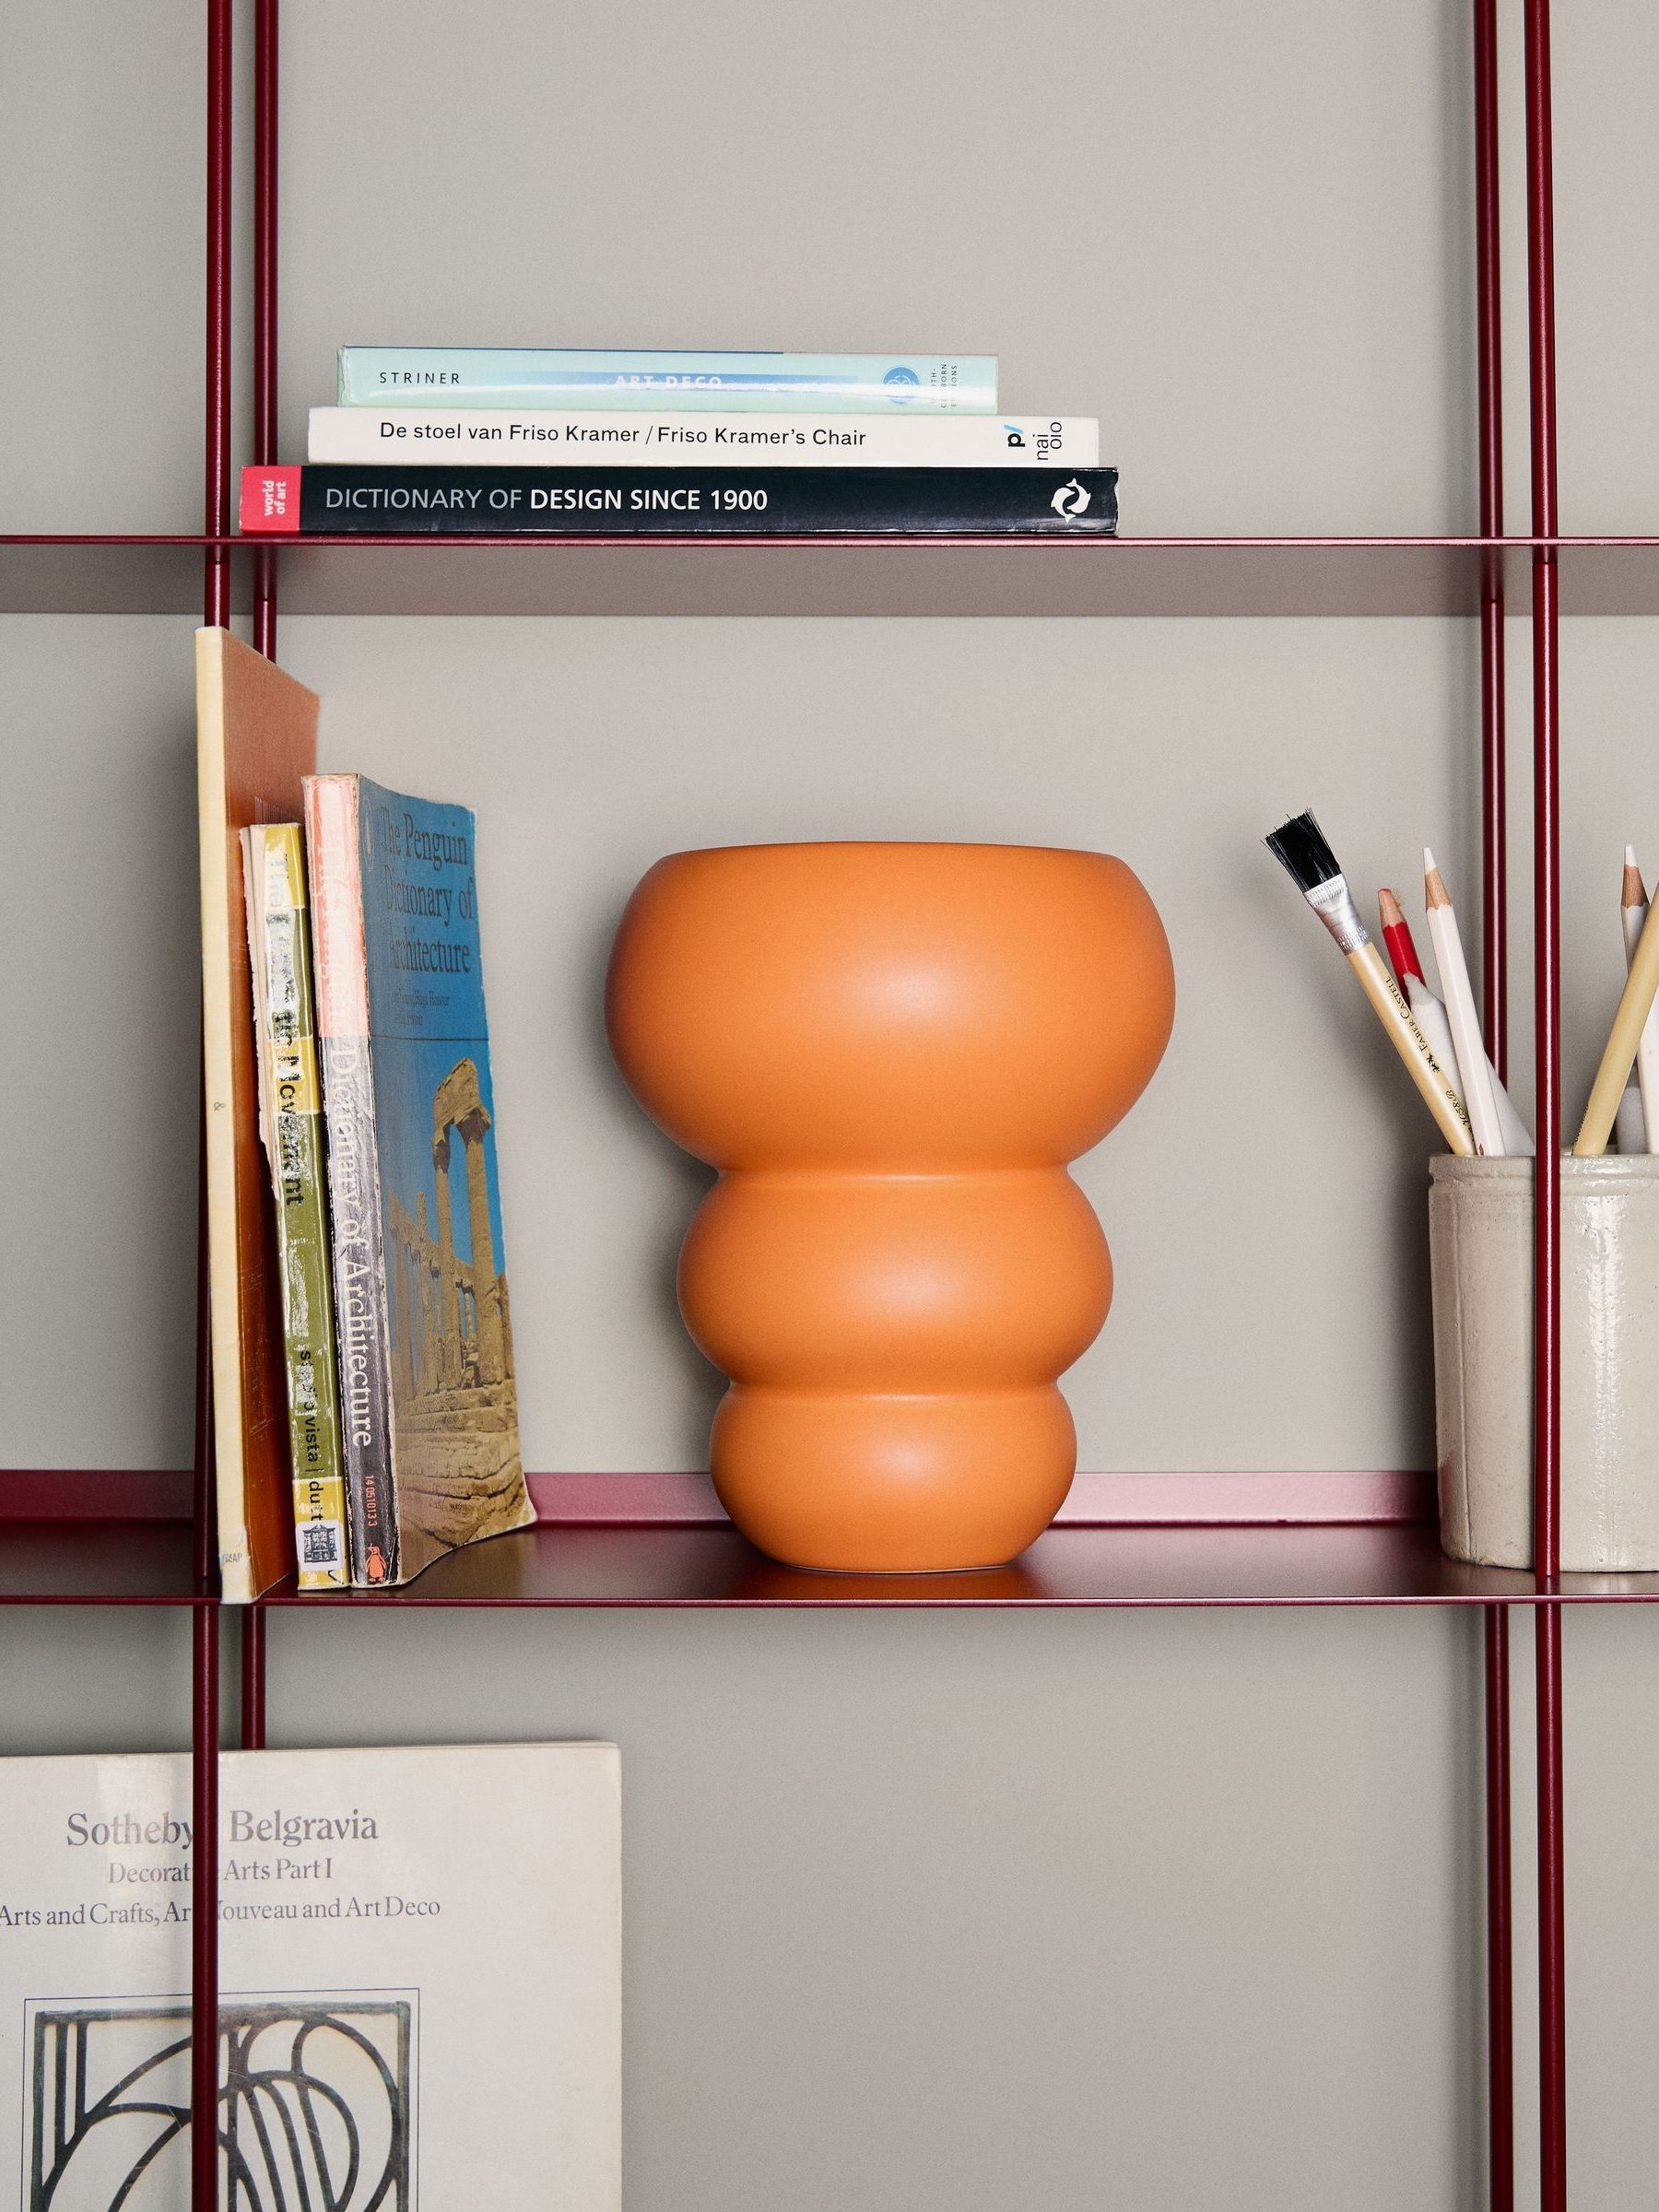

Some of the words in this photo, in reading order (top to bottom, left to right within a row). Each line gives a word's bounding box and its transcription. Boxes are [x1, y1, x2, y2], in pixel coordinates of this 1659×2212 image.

[379, 371, 461, 384] STRINER
[380, 421, 407, 439] De
[413, 422, 462, 441] stoel
[467, 427, 502, 441] van
[509, 424, 559, 441] Friso
[566, 425, 641, 442] Kramer
[657, 426, 708, 443] Friso
[714, 428, 806, 445] Kramer's
[812, 429, 867, 446] Chair
[1032, 434, 1049, 461] nai
[262, 480, 275, 517] world
[274, 500, 286, 514] of
[276, 481, 287, 500] art
[325, 488, 483, 510] DICTIONARY
[488, 488, 523, 510] OF
[530, 488, 622, 511] DESIGN
[629, 488, 700, 511] SINCE
[710, 489, 769, 512] 1900
[380, 806, 402, 857] The
[403, 812, 468, 872] Penguin
[383, 865, 453, 927] Dictionary
[457, 877, 476, 919] of
[389, 924, 471, 974] Architecture
[1385, 975, 1429, 1053] FABER-CASTELL
[329, 1049, 363, 1213] Dictionary
[340, 1218, 370, 1251] of
[342, 1257, 375, 1448] Architecture
[305, 1416, 322, 1463] vista
[66, 1811, 193, 1851] Sotheby
[229, 1808, 380, 1848] Belgravia
[109, 1861, 192, 1884] Decorat
[223, 1859, 271, 1881] Arts
[276, 1858, 322, 1880] Part
[324, 1857, 333, 1879] I
[0, 1904, 41, 1926] Arts
[46, 1902, 86, 1925] and
[90, 1901, 160, 1927] Crafts,
[163, 1900, 192, 1924] Ar
[302, 1897, 341, 1919] and
[345, 1895, 382, 1918] Art
[383, 1895, 441, 1917] Deco
